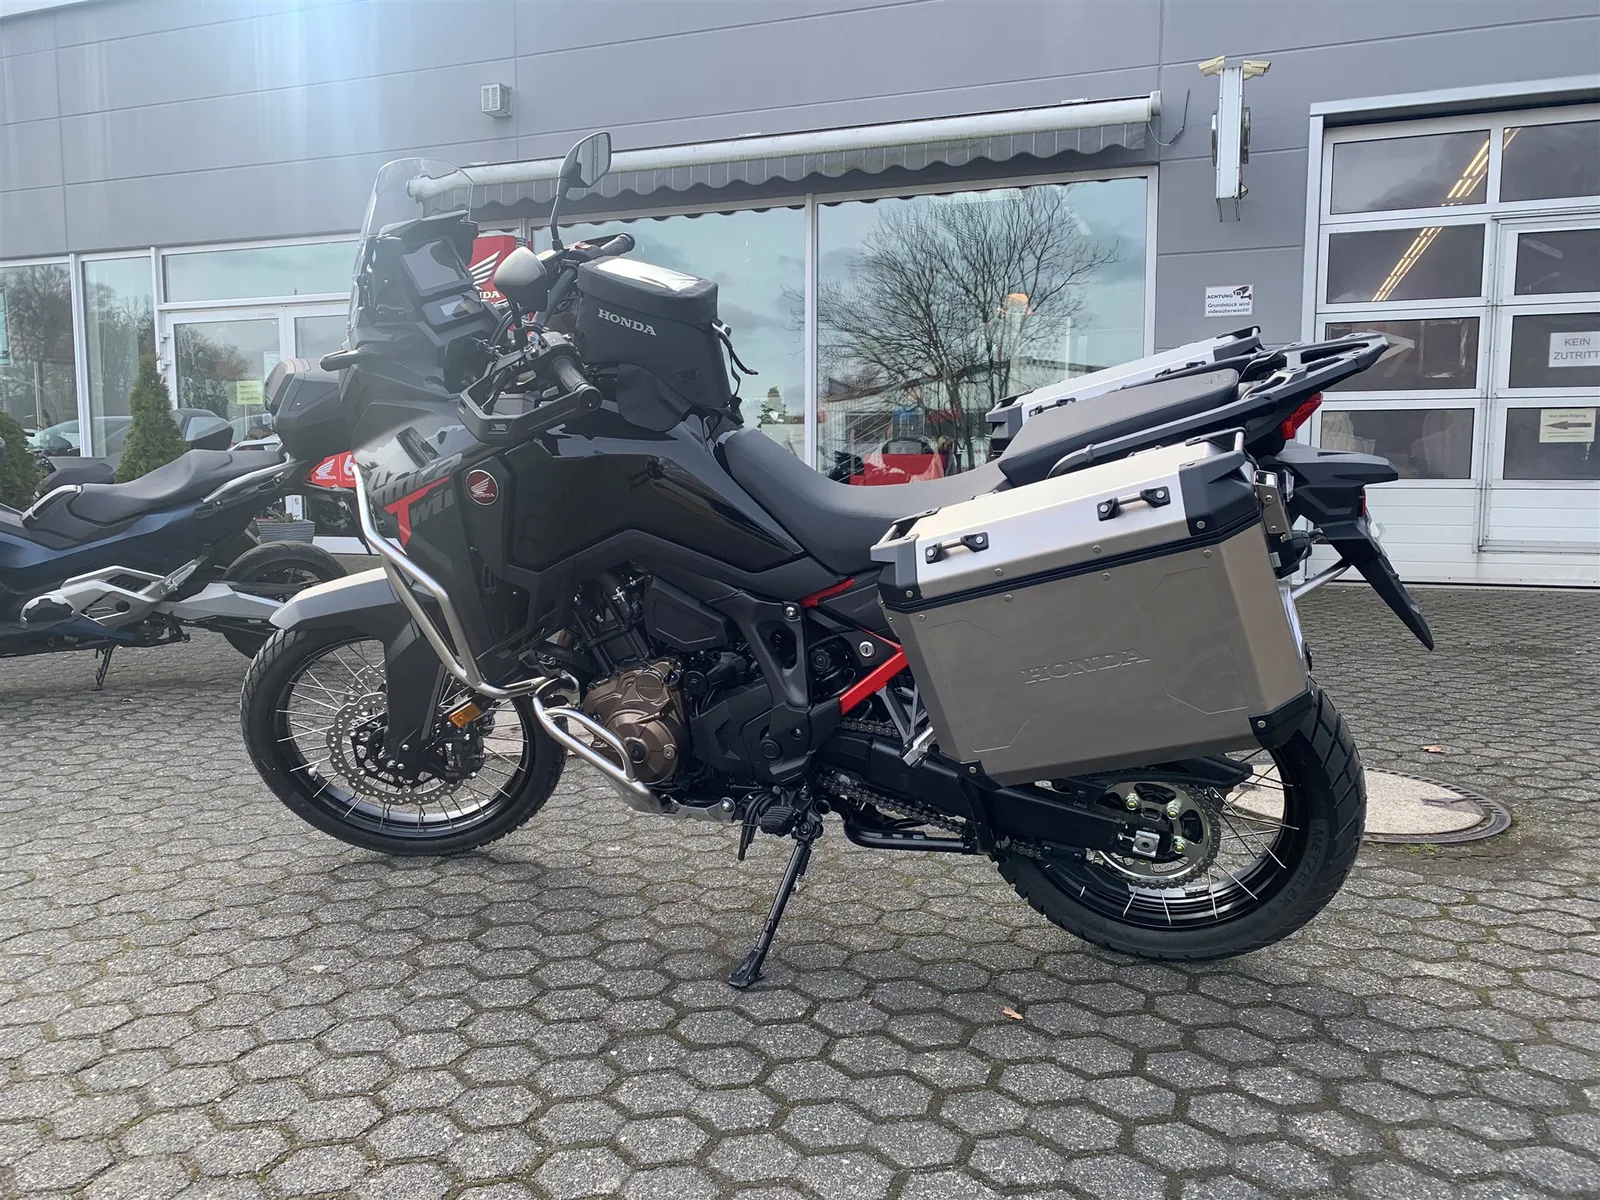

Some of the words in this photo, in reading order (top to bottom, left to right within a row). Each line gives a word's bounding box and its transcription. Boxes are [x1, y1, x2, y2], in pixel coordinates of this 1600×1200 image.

[597, 307, 657, 336] HONDA
[1553, 350, 1600, 361] ZUTRITT
[1564, 337, 1591, 347] KEIN
[1019, 647, 1150, 685] HONDA
[1279, 828, 1325, 907] METZELER
